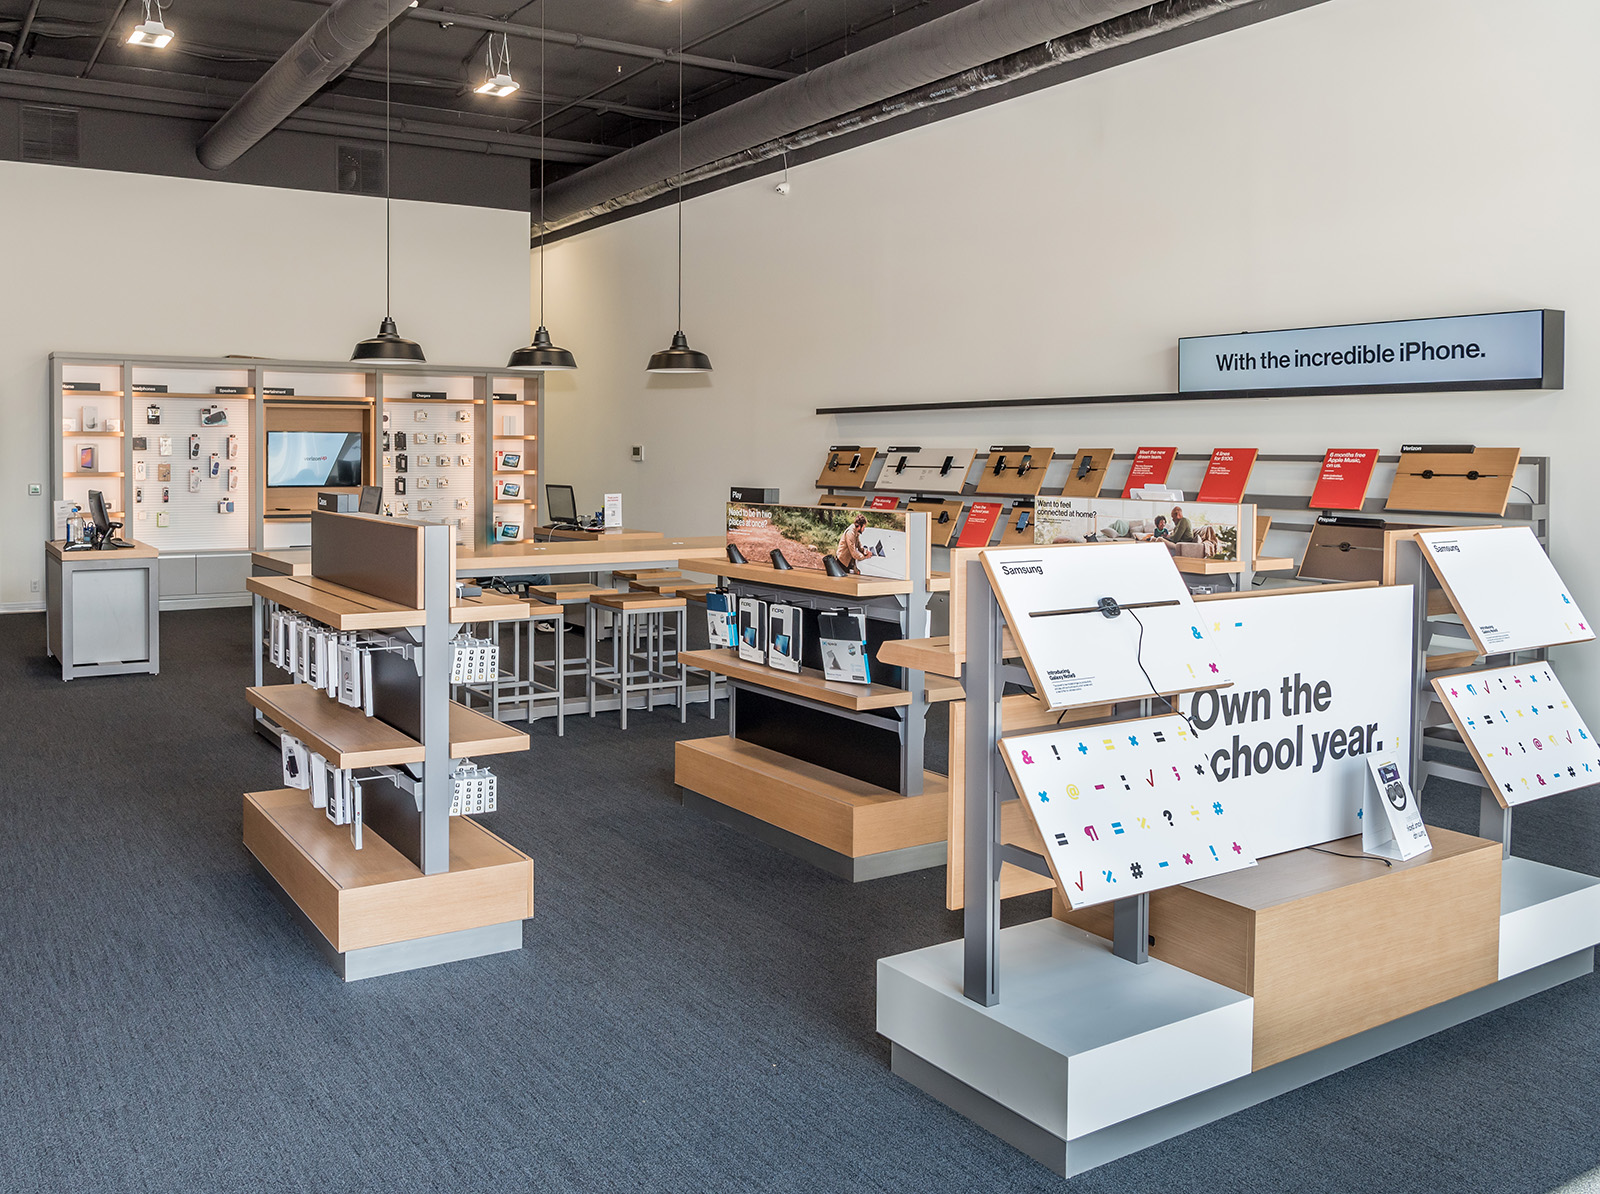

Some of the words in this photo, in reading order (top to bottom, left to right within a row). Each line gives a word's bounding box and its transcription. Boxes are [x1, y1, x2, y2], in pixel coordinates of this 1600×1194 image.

[1215, 352, 1257, 371] With
[1260, 351, 1291, 369] the
[1294, 344, 1395, 367] incredible
[1399, 341, 1487, 362] iPhone.
[732, 491, 742, 500] Play
[728, 507, 742, 516] Need
[749, 509, 756, 517] be
[756, 509, 762, 517] in
[762, 510, 772, 518] two
[728, 517, 745, 527] places
[752, 520, 767, 528] once?
[1001, 565, 1044, 576] Samsung
[1191, 688, 1271, 731] Own
[1280, 672, 1332, 717] the
[1204, 724, 1303, 783] chool
[1311, 722, 1383, 773] year.
